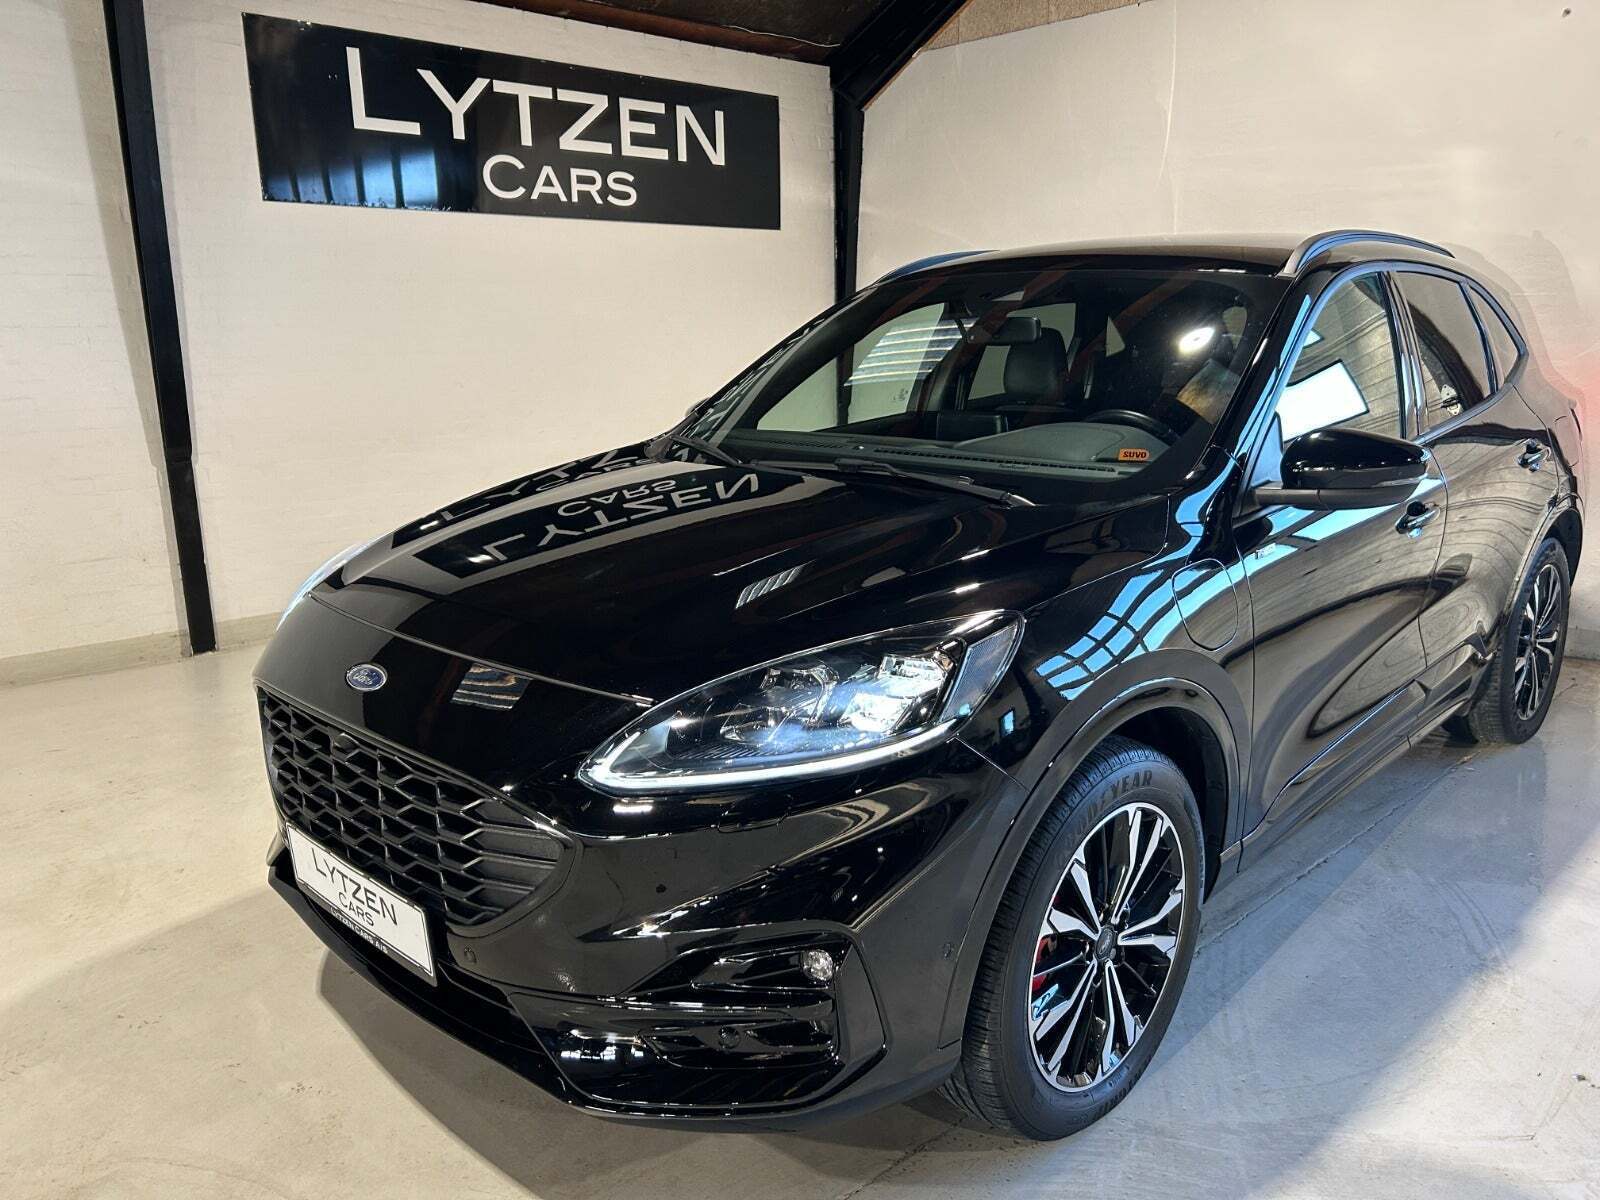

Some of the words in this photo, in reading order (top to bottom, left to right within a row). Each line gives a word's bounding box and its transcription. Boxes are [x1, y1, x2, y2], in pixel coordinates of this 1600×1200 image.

[346, 46, 725, 167] LYTZEN
[482, 154, 638, 207] CARS
[311, 847, 398, 926] LYTZEN
[338, 891, 375, 927] CARS
